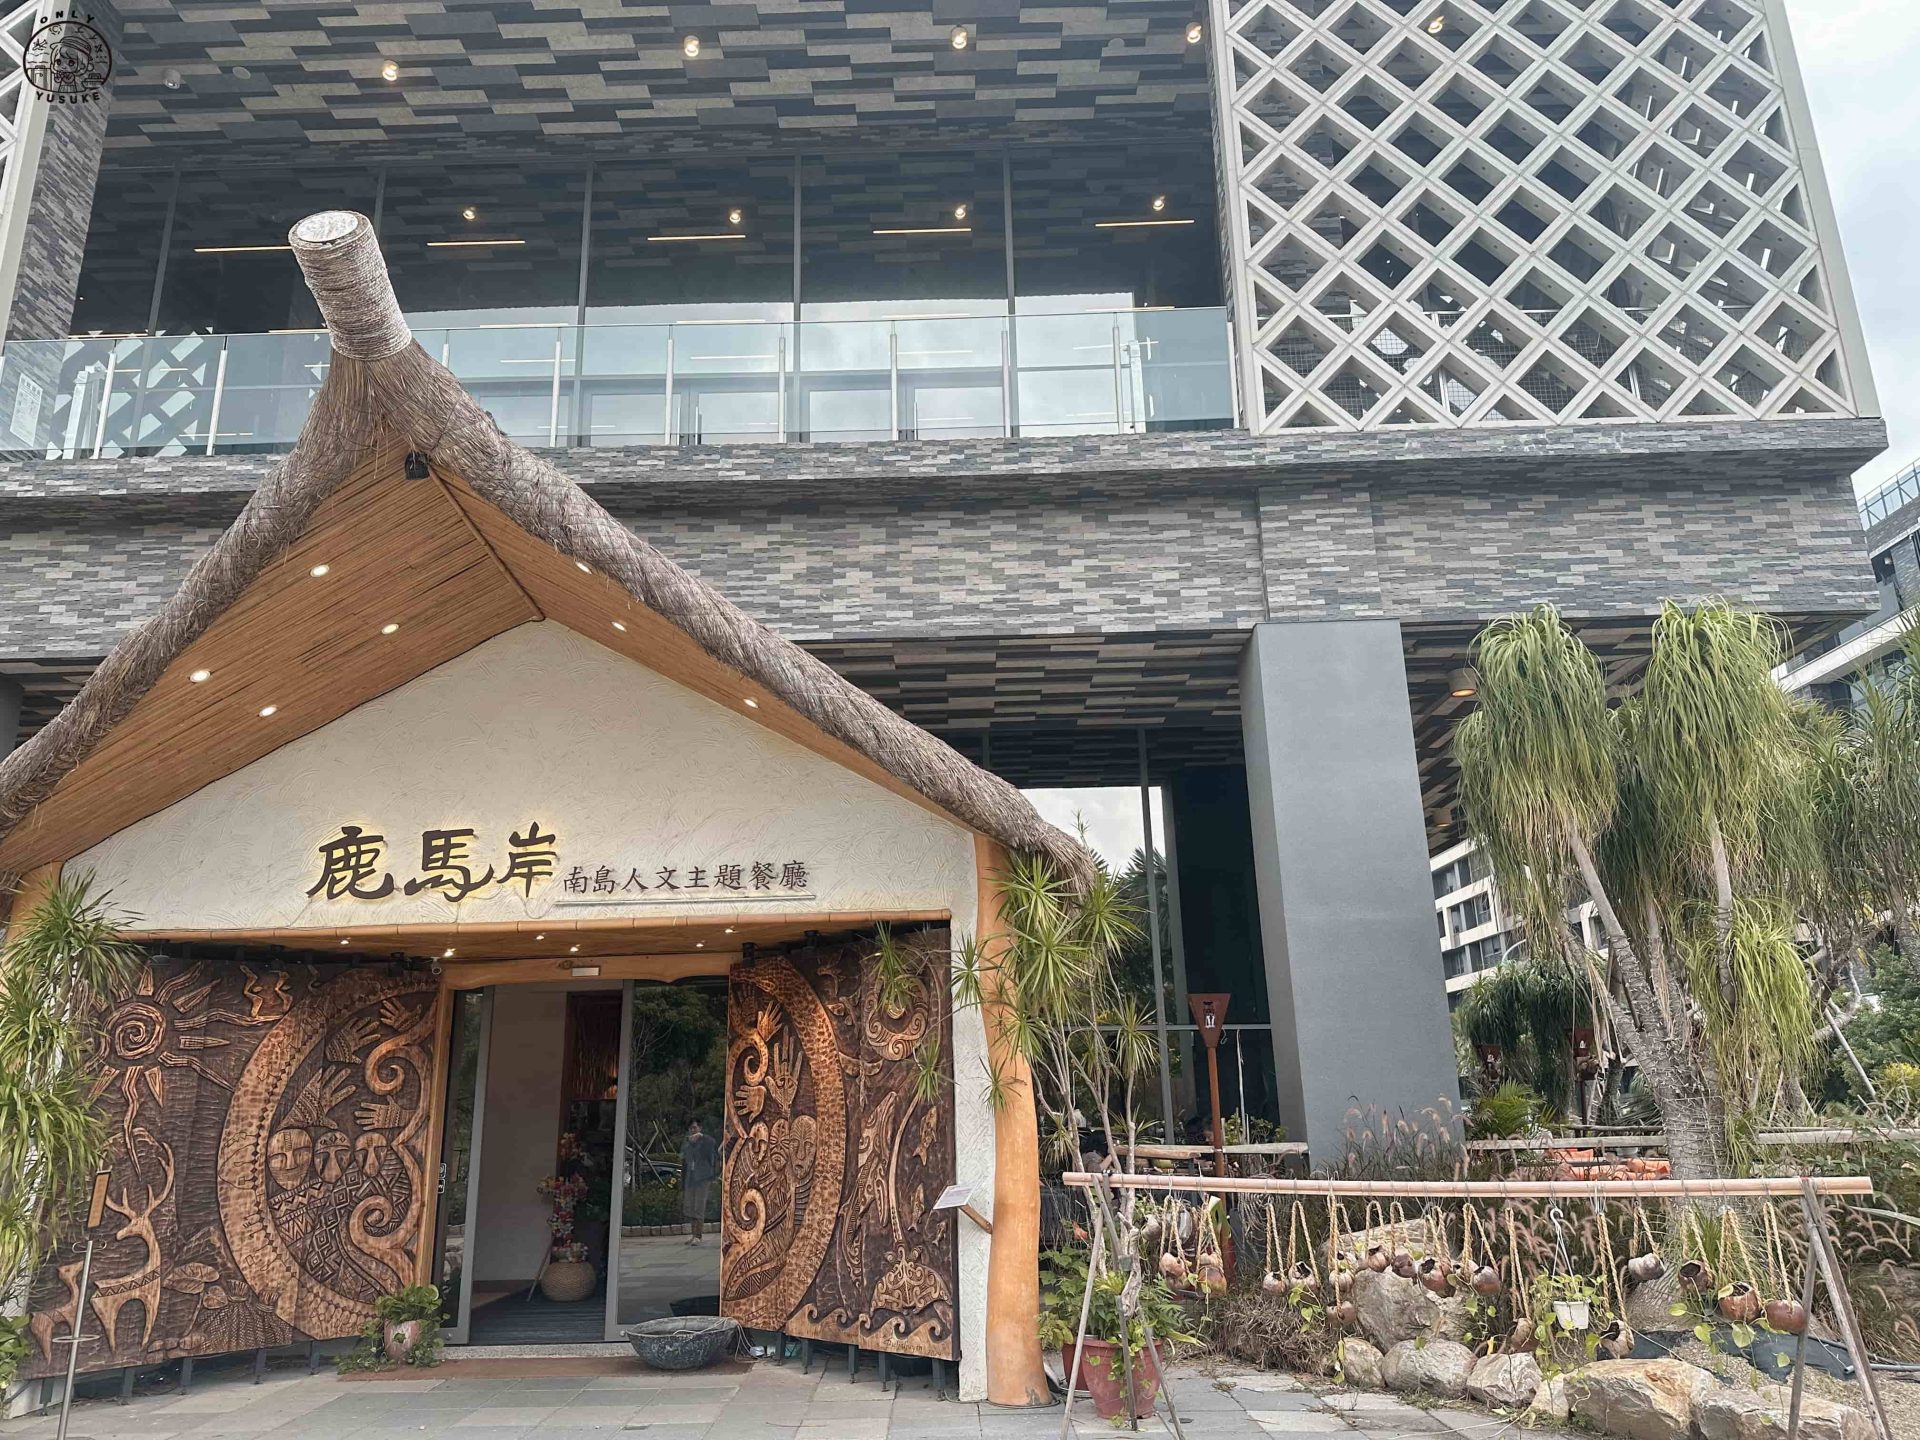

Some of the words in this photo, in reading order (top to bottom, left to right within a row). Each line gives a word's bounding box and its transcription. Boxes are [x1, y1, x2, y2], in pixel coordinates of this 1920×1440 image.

[305, 819, 557, 903] 鹿馬岸
[563, 859, 808, 895] 南島人文主題餐廳
